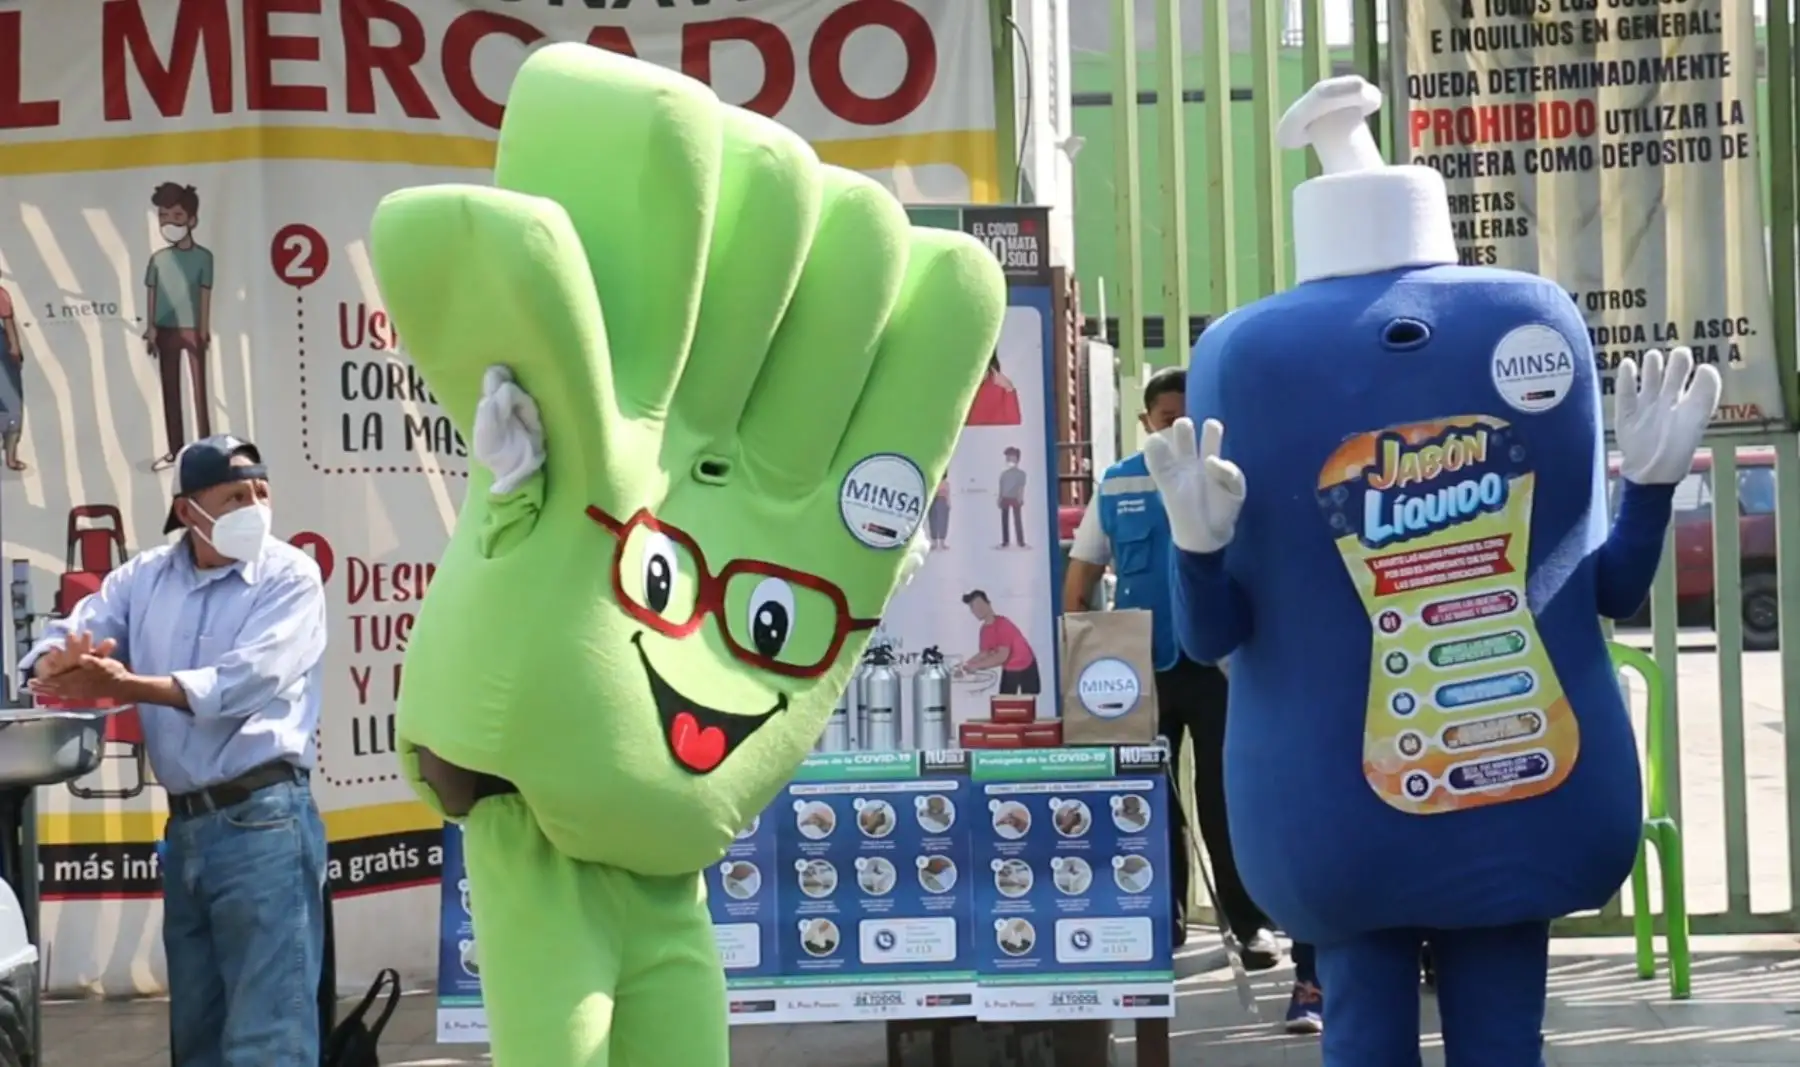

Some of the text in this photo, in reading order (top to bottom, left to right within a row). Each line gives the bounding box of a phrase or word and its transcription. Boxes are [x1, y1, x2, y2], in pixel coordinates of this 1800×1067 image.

[1431, 12, 1723, 54] E INQUILINOS EN GENERAL:
[102, 0, 937, 132] MERCDO
[1408, 53, 1732, 102] QUEDA DETERMINADAMENTE
[1410, 99, 1745, 147] PROHIBIDO UTILIZAR LA
[1525, 146, 1593, 175] COMO
[1603, 138, 1712, 169] DEPOSITO
[1721, 133, 1750, 160] DE
[987, 222, 1019, 236] COVID
[1007, 236, 1038, 251] MATA
[283, 235, 314, 278] 2
[1007, 251, 1039, 267] SOLO
[1459, 245, 1498, 266] HES
[45, 300, 118, 318] 1 metro
[1586, 288, 1647, 311] OTROS
[1654, 322, 1679, 344] LA
[1693, 316, 1758, 341] ASOC.
[1495, 351, 1572, 378] MINSA
[1728, 344, 1742, 363] A
[341, 361, 438, 405] CORR
[342, 412, 383, 452] LA
[1367, 429, 1488, 490] JABÓN
[845, 478, 920, 516] MINSA
[1364, 472, 1502, 543] LÍQUIDO
[350, 664, 371, 705] Y
[1082, 678, 1136, 694] MINSA
[854, 752, 912, 764] COVID-19
[1048, 751, 1107, 763] COVID-19
[54, 851, 164, 881] más inf
[349, 842, 418, 883] gratis
